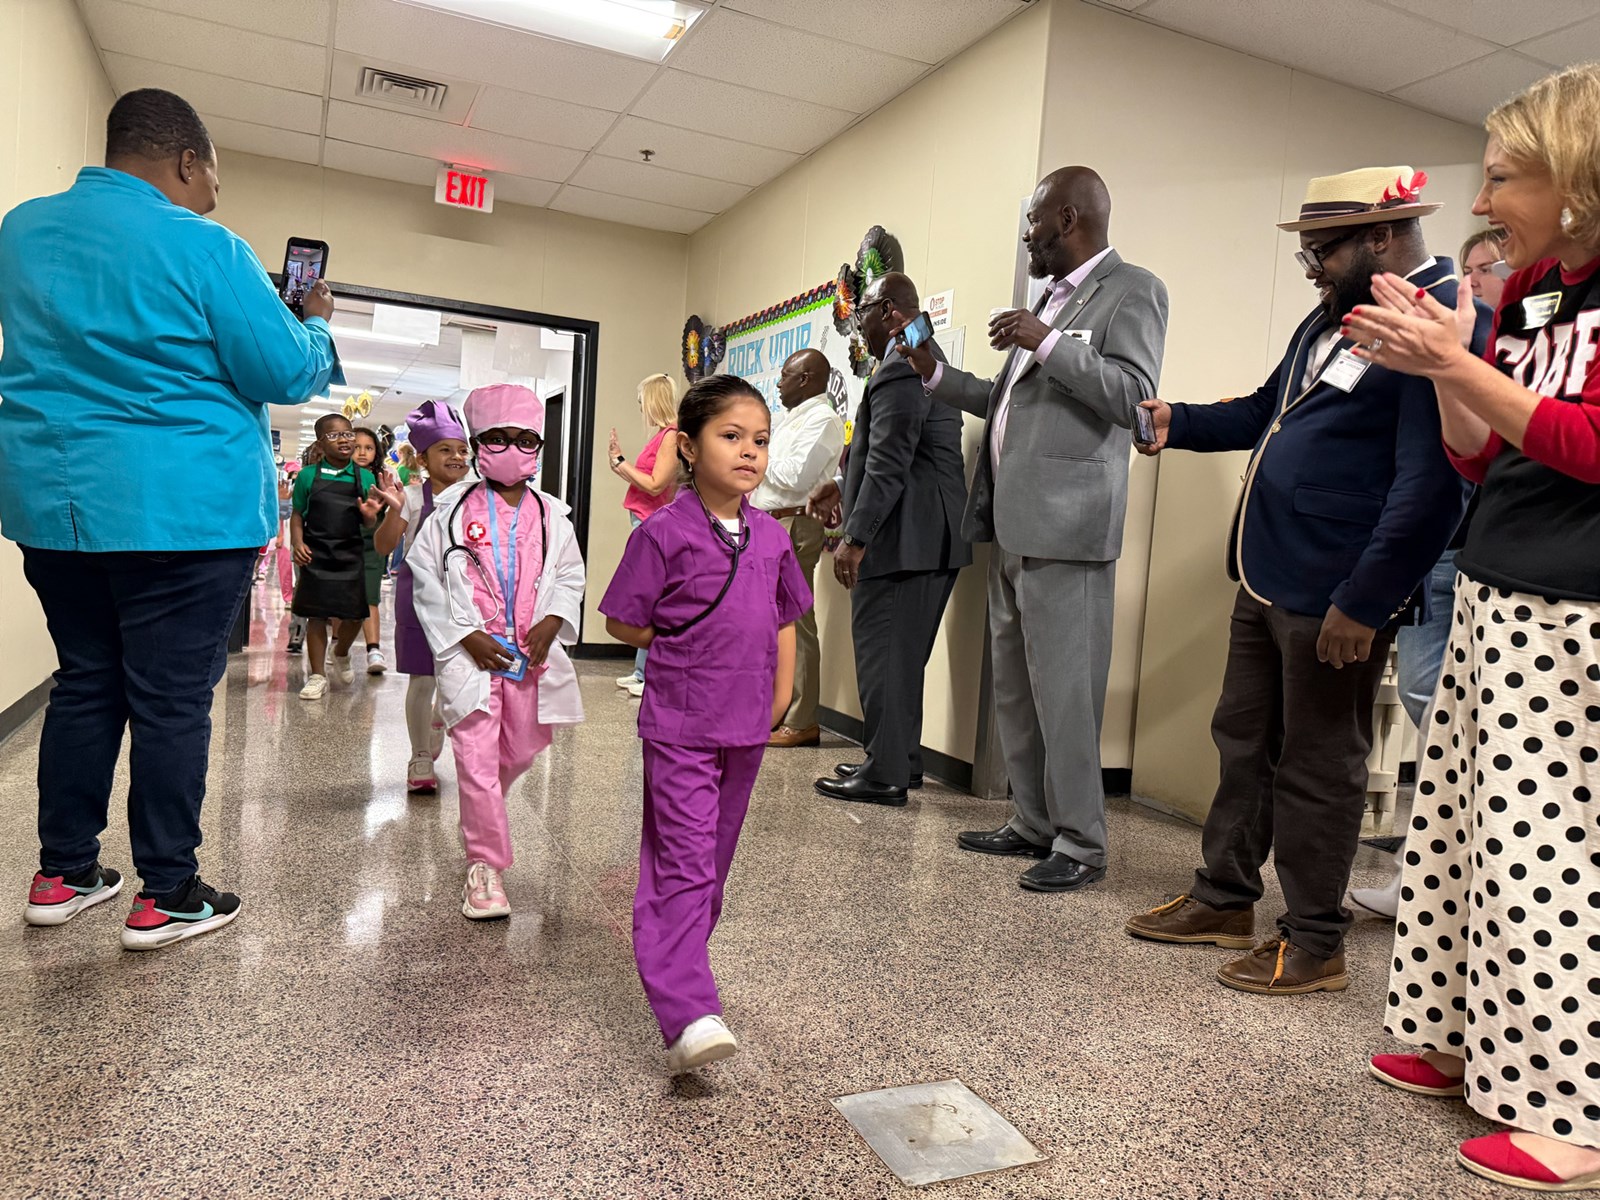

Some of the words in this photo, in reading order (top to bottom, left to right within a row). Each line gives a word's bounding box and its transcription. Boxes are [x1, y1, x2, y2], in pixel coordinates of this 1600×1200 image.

[445, 170, 488, 209] EXIT
[728, 338, 765, 377] ROCK
[769, 322, 811, 370] YOUR
